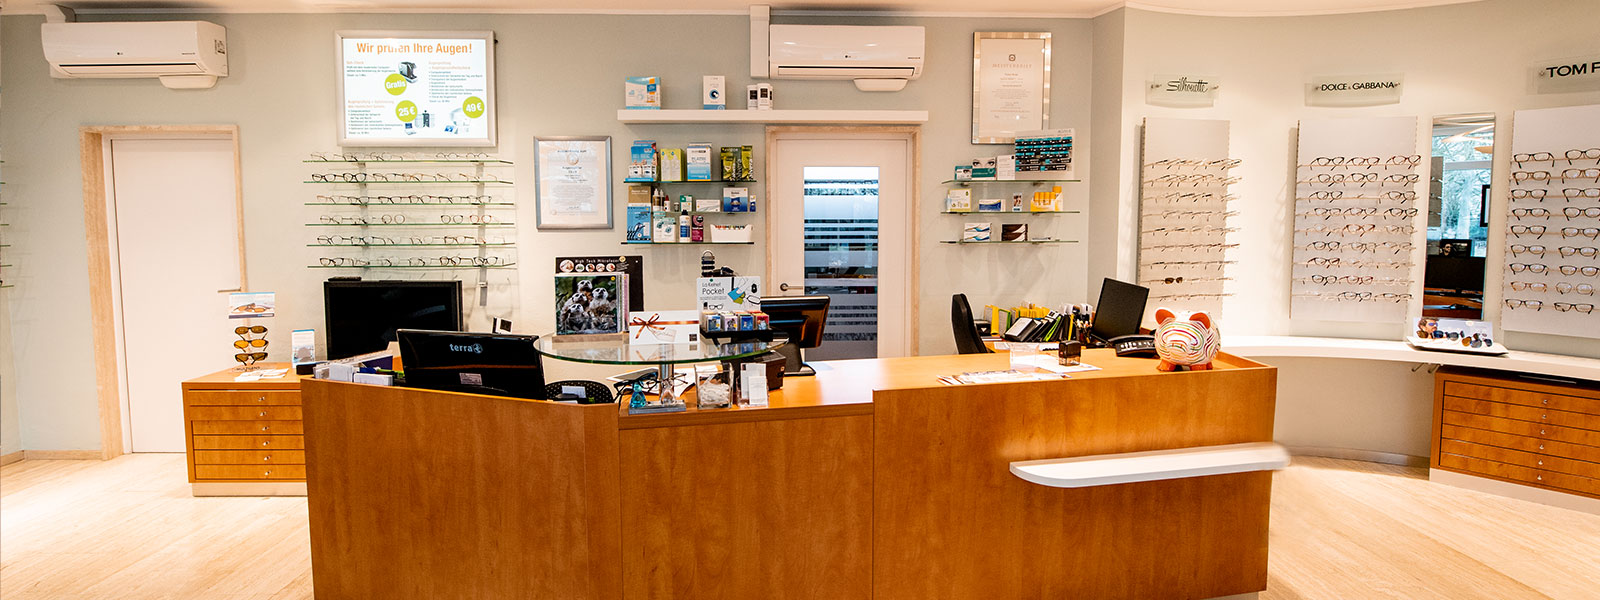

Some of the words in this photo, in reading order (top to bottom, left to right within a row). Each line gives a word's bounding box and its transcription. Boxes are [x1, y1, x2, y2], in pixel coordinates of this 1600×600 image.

[356, 42, 374, 54] Wir
[413, 42, 433, 54] Ihre
[435, 42, 473, 56] Augen!
[1545, 63, 1587, 78] TOM
[385, 80, 406, 90] Gratis
[1166, 77, 1208, 93] Silhouette
[1321, 83, 1347, 92] DOLCE
[1351, 81, 1395, 91] GABBANA
[398, 107, 409, 117] 25
[702, 287, 725, 295] Pocket
[449, 343, 473, 352] terra
